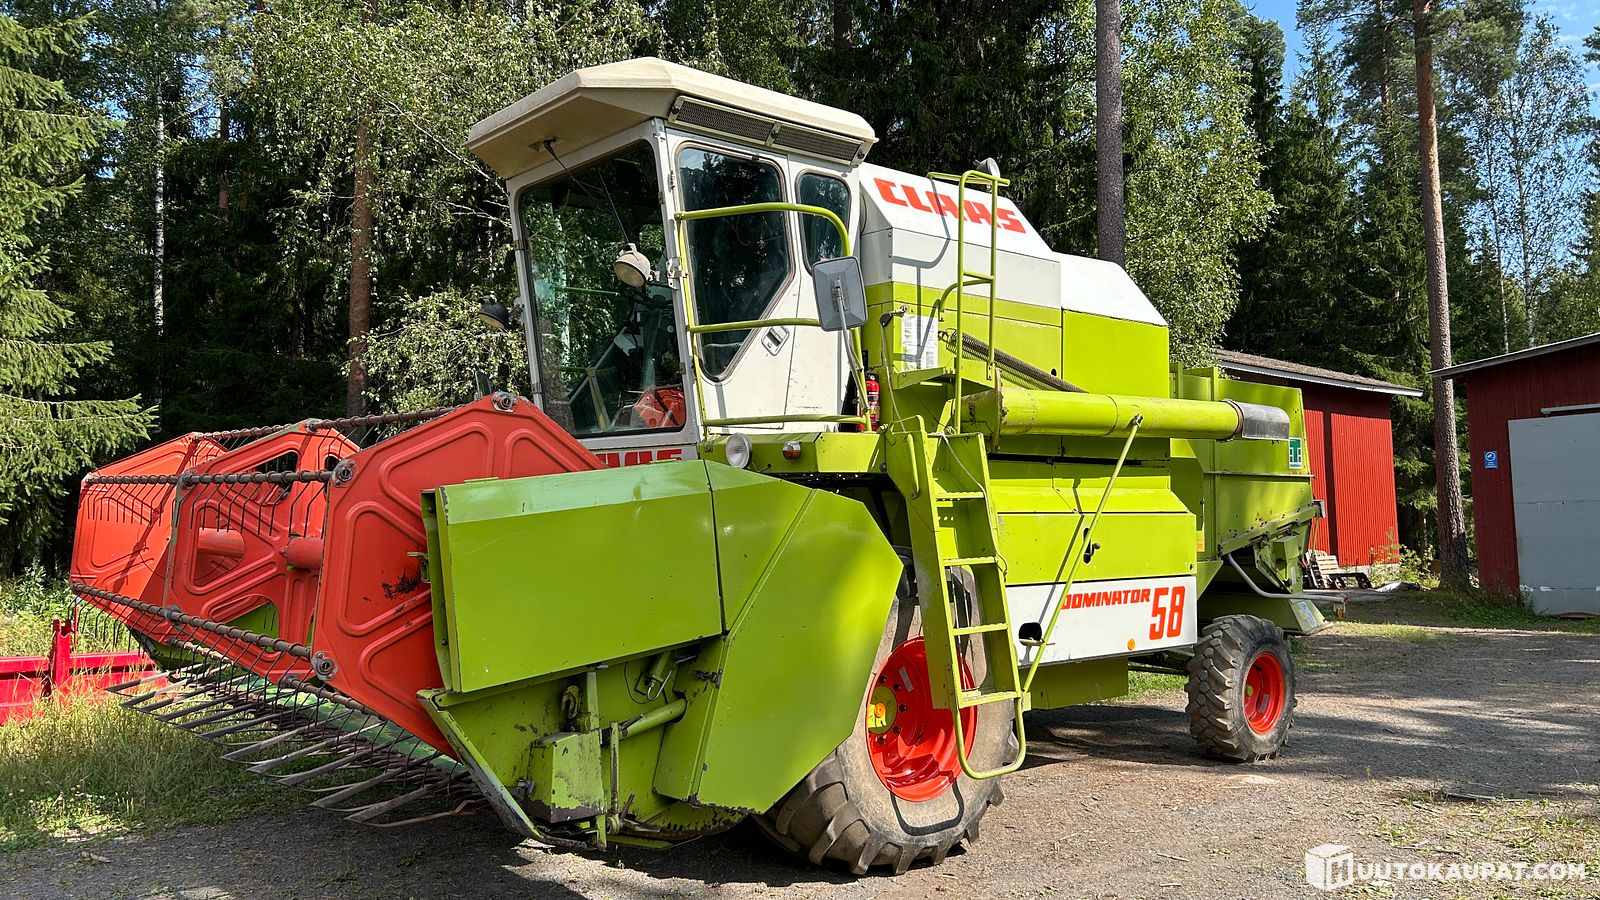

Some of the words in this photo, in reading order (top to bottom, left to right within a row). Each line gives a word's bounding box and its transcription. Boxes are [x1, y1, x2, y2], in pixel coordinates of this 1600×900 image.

[874, 177, 1027, 234] CLAAS
[1061, 588, 1150, 610] DOMINATOR
[1149, 585, 1186, 640] 58
